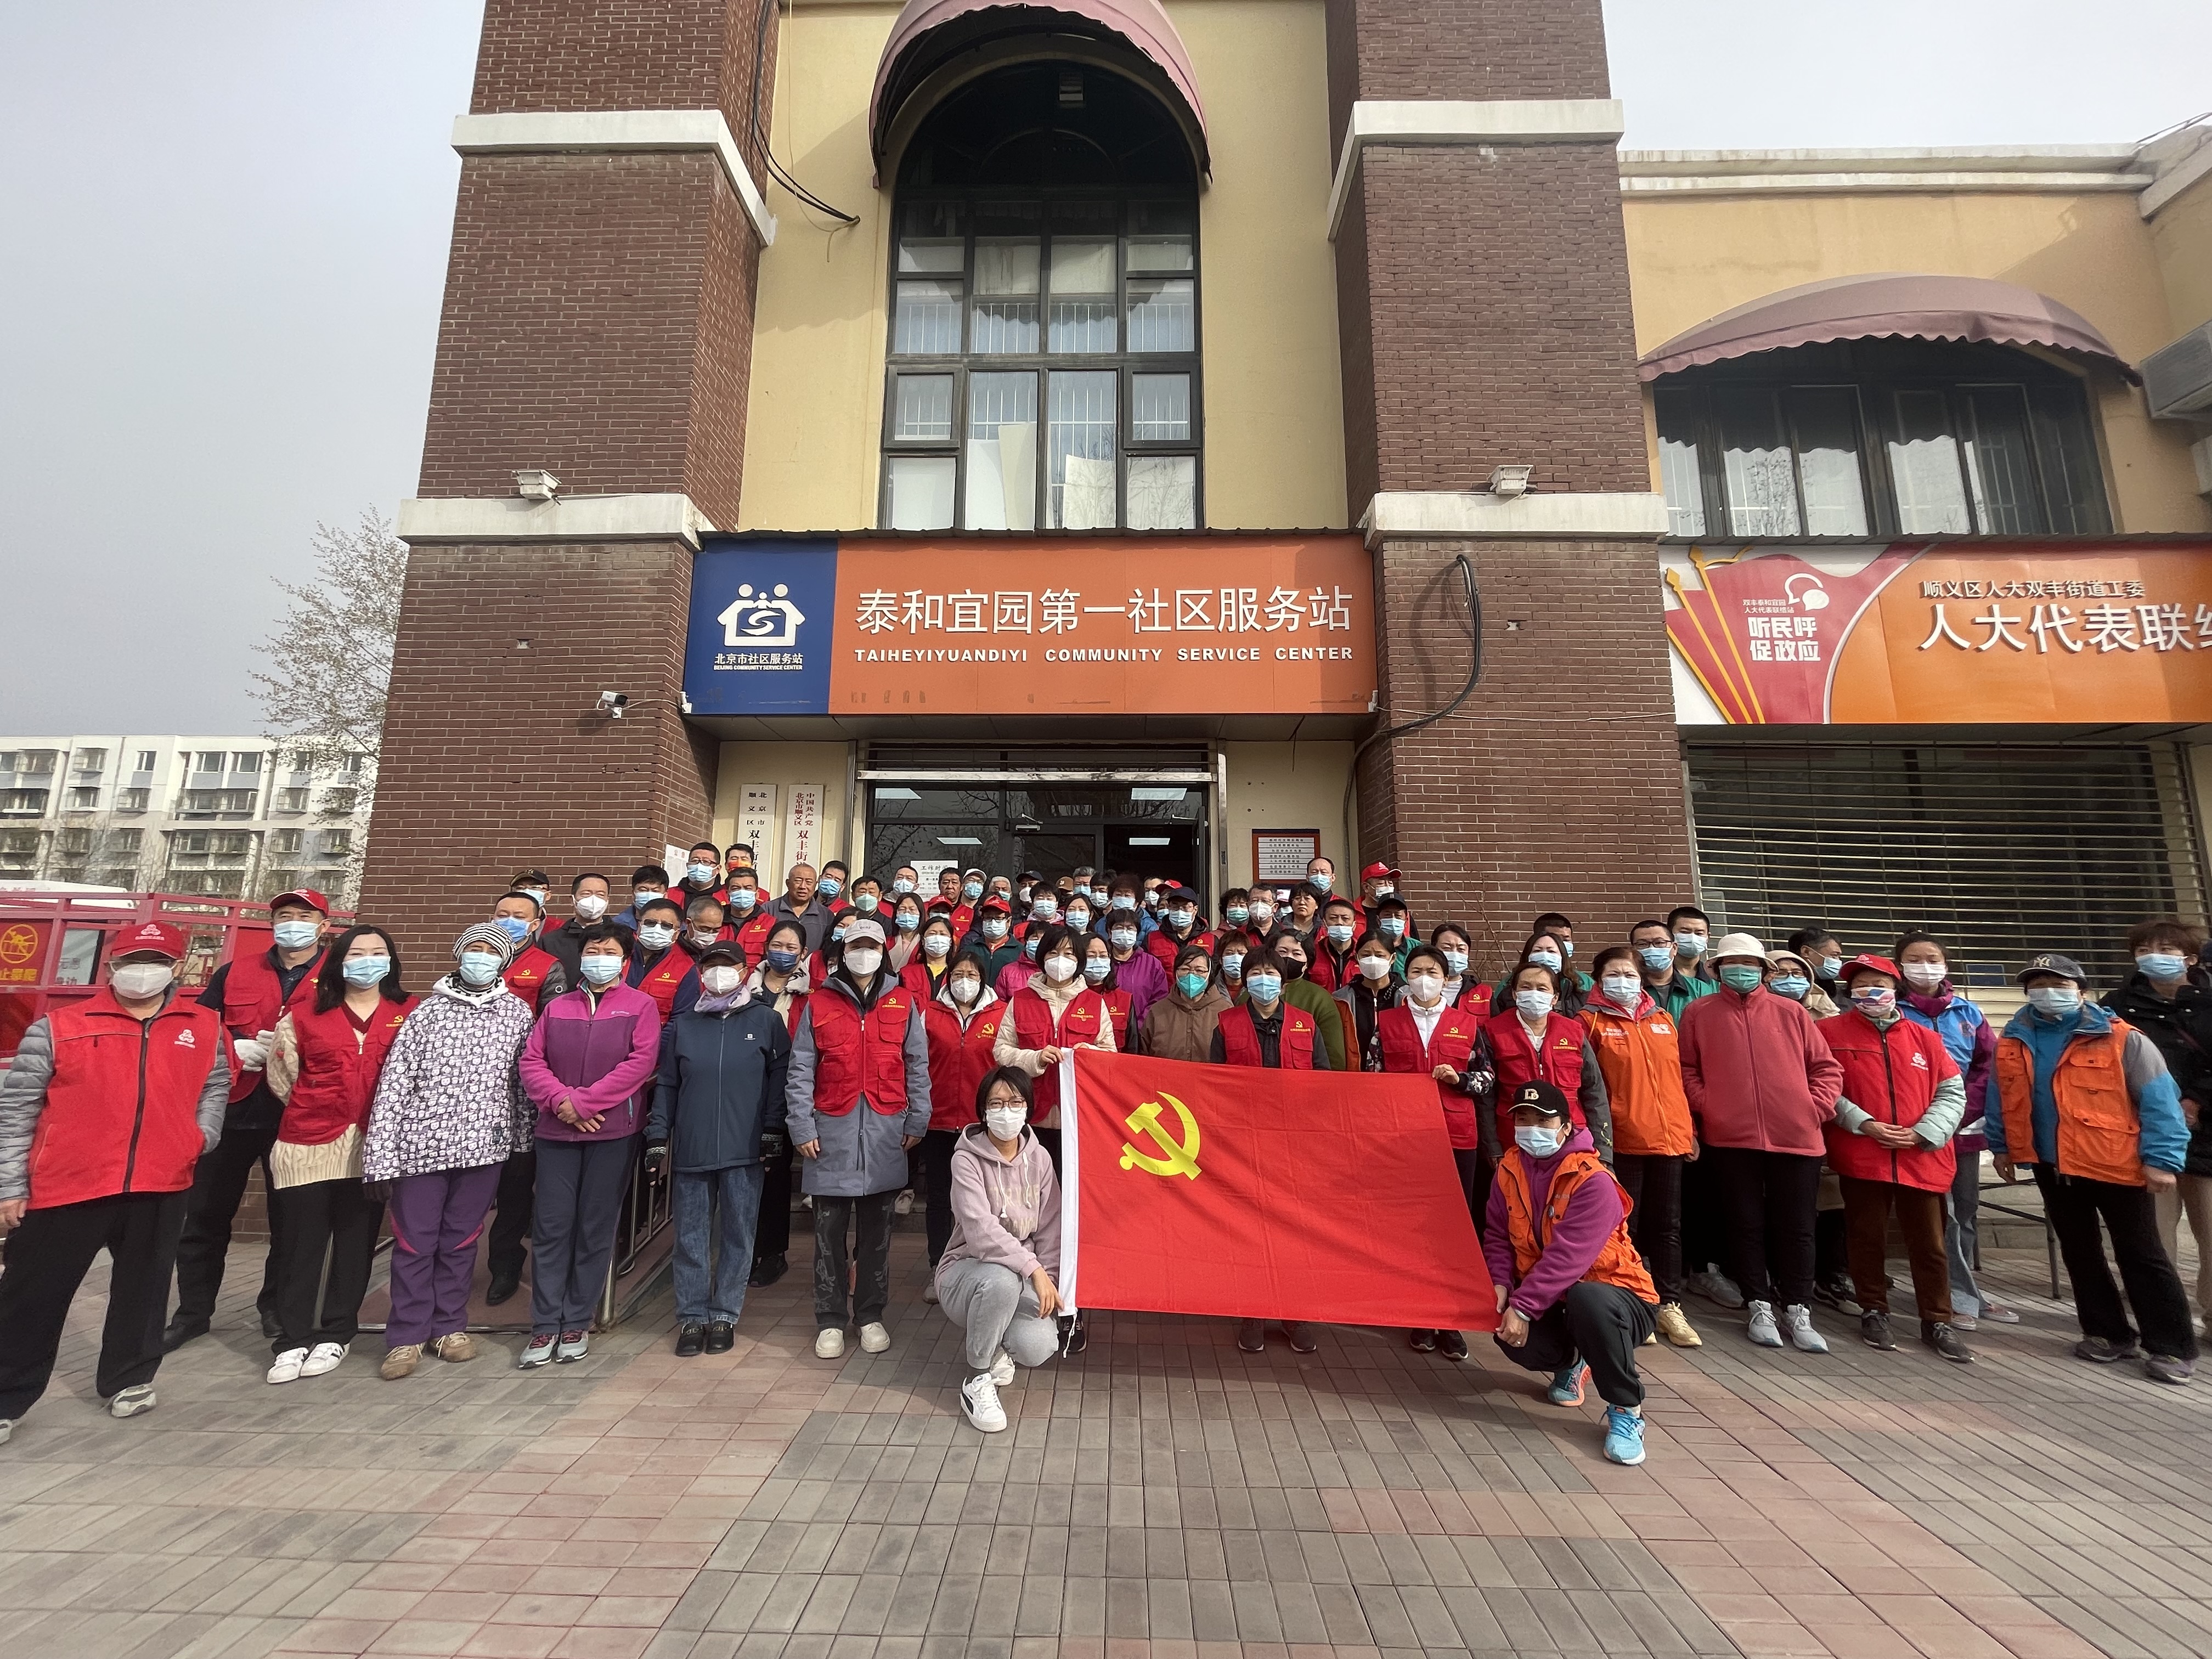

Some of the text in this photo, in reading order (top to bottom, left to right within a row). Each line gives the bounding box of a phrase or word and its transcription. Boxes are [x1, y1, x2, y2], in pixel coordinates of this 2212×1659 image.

[1923, 579, 2146, 598] 顺义区人大双丰街道工委
[856, 585, 1353, 635] 泰和宜园第一社区服务站
[1747, 617, 1818, 639] 听民呼
[714, 653, 804, 664] 北京市社区服务站
[855, 647, 1353, 662] TAIHEYIYUANDIYI COMMUNITY SERVICE CENTER
[1749, 639, 1821, 662] 促政应
[805, 792, 815, 826] 中国共产党
[795, 830, 809, 865] 双丰街
